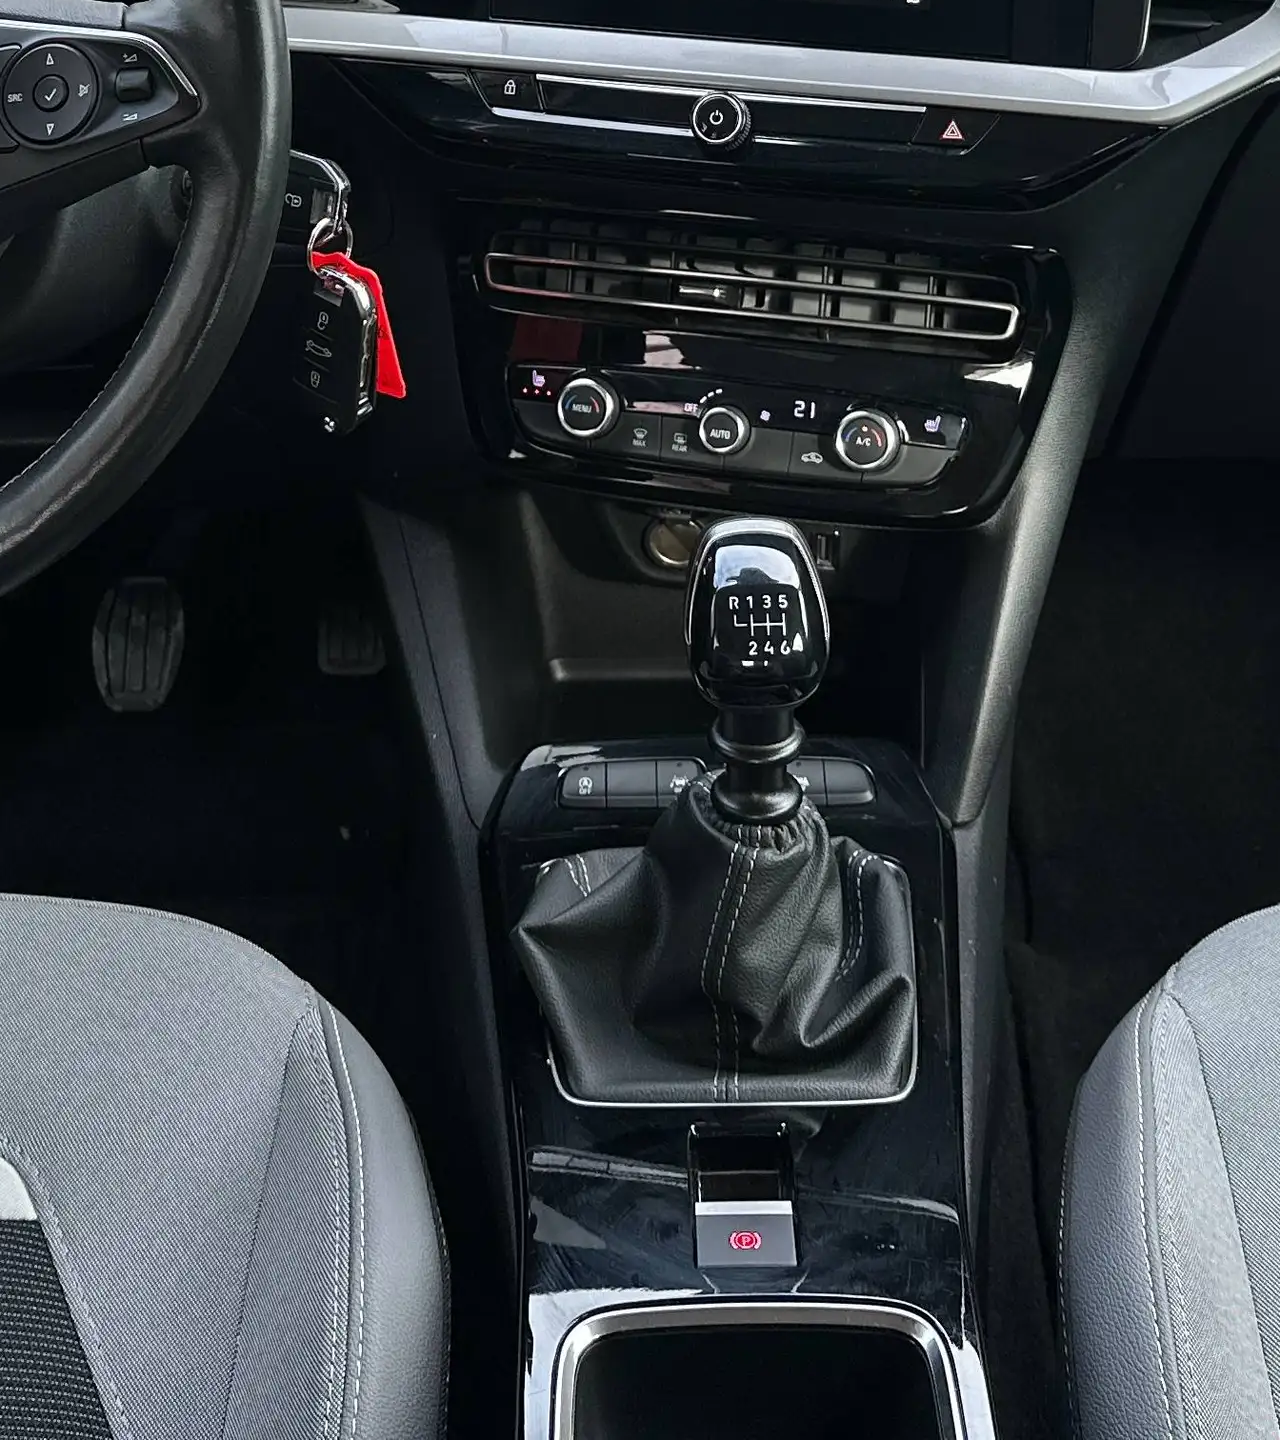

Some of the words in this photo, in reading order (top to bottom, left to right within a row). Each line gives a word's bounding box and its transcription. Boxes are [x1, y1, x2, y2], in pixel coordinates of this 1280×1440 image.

[7, 94, 23, 103] SRC
[572, 403, 592, 414] MENU
[684, 403, 698, 412] OFF
[794, 400, 816, 419] 21
[710, 429, 731, 440] AUTO
[633, 439, 646, 448] MAX
[856, 436, 871, 447] A/C
[672, 443, 688, 453] REAR
[729, 596, 739, 610] R
[746, 595, 753, 609] 1
[762, 594, 771, 608] 3
[778, 594, 788, 608] 5
[749, 641, 758, 655] 2
[764, 640, 774, 655] 4
[780, 640, 791, 655] 6
